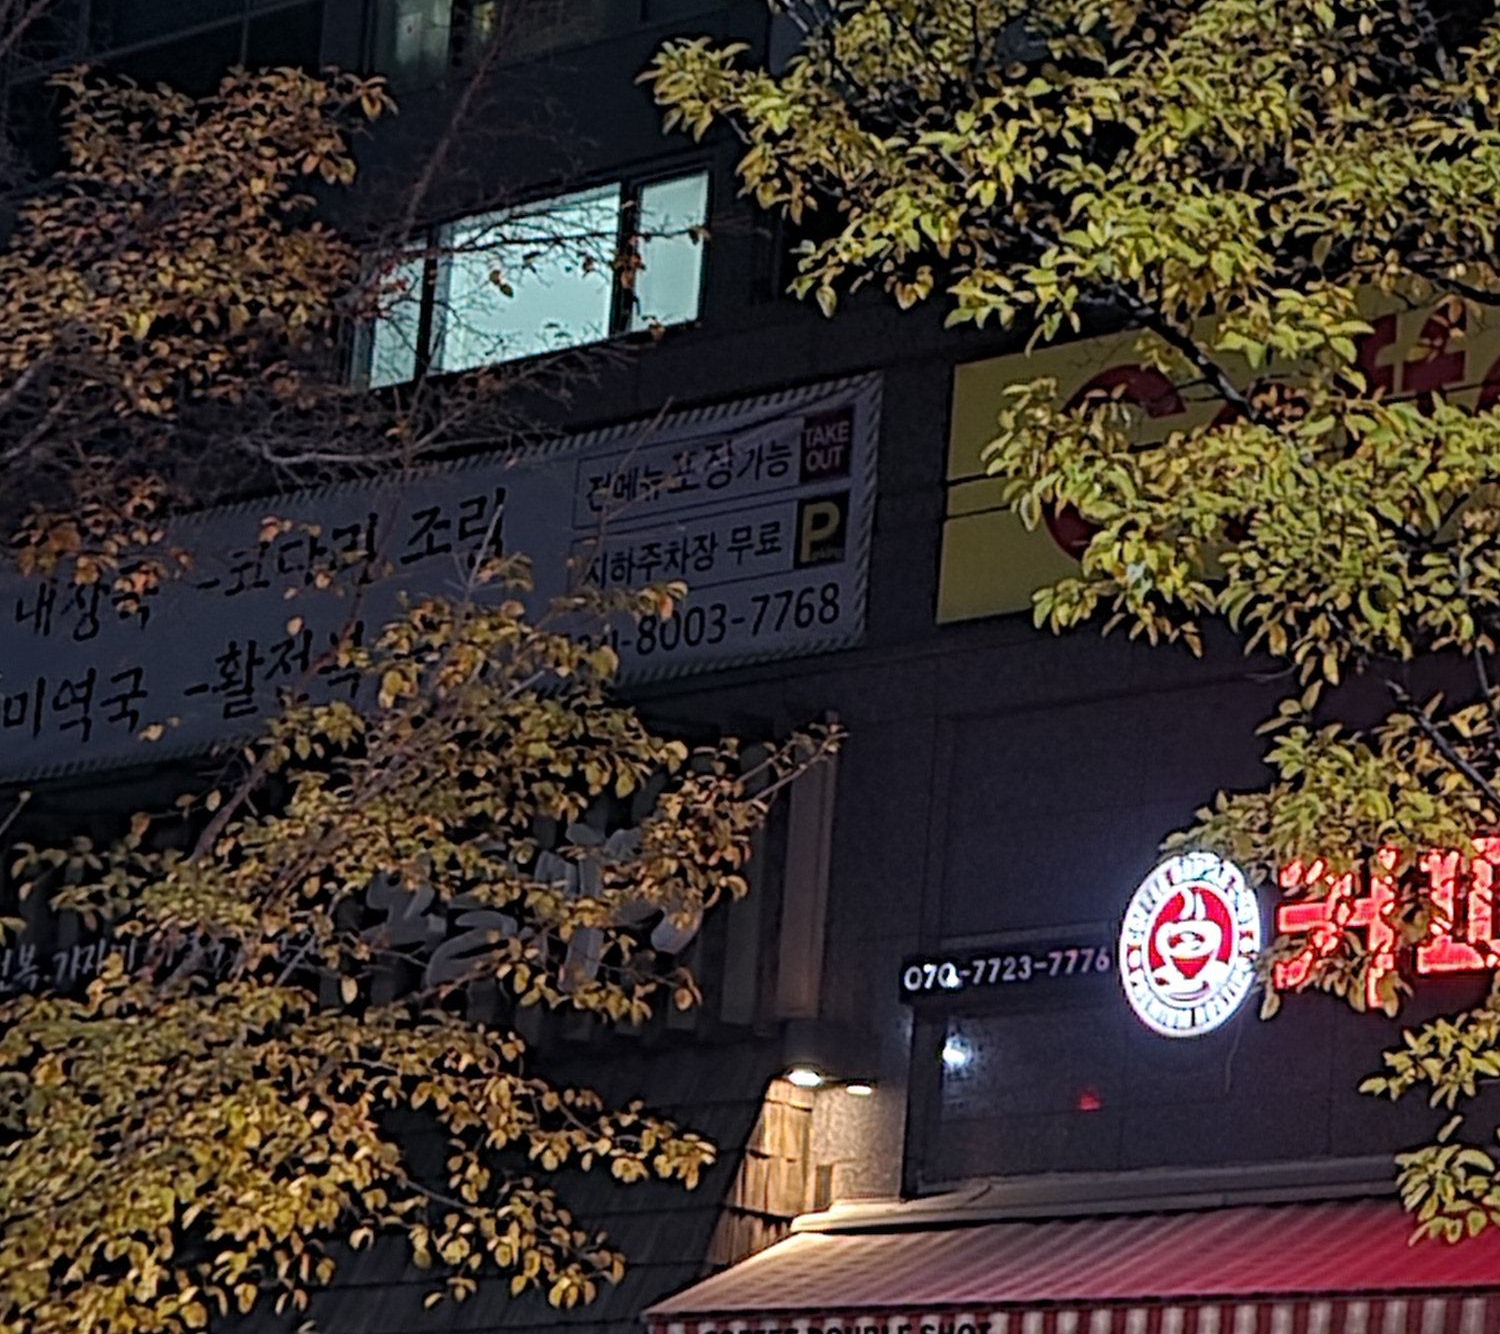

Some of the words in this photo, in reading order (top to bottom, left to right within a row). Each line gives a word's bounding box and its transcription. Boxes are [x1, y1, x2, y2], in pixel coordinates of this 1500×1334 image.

[804, 419, 851, 449] TAKE
[804, 444, 845, 474] OUT
[727, 520, 783, 566] 무료
[799, 499, 842, 565] P
[2, 666, 149, 744] 미역국
[903, 945, 1111, 992] 070-7723-7776
